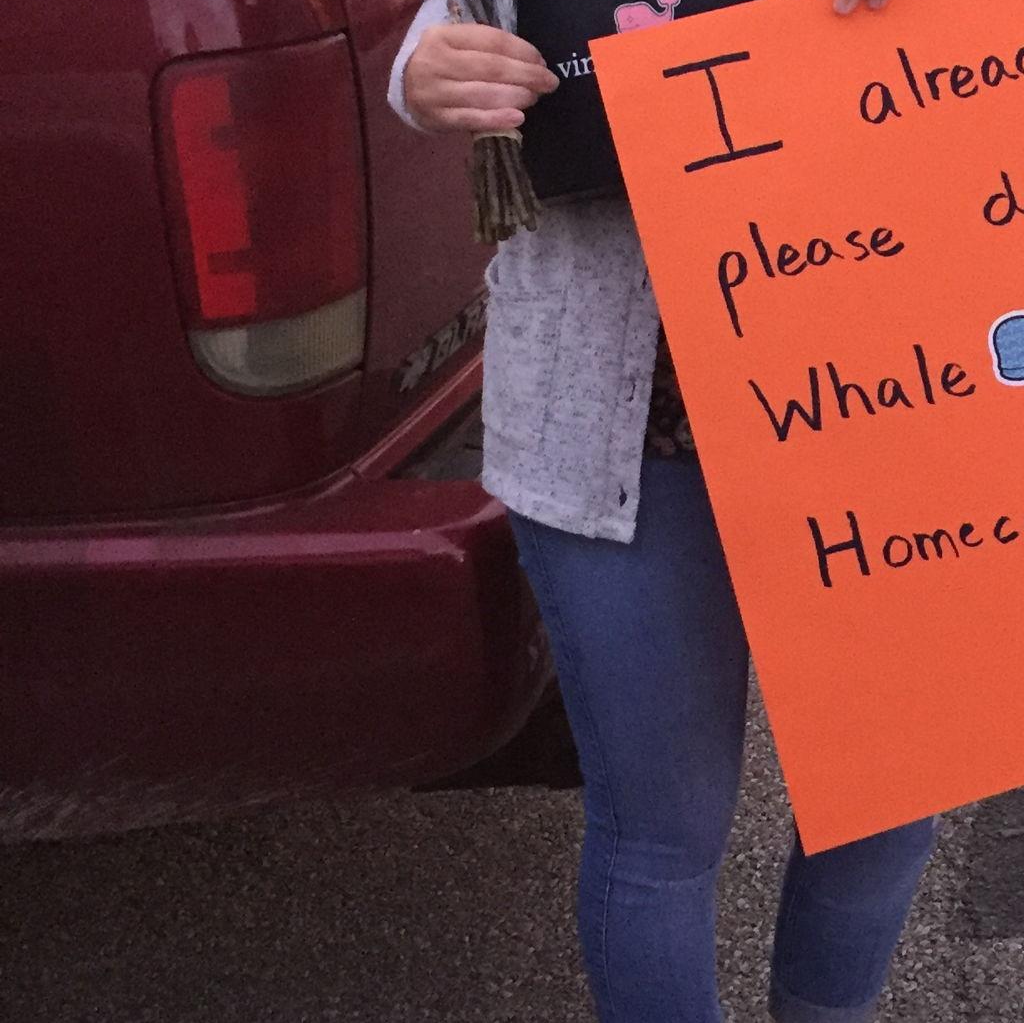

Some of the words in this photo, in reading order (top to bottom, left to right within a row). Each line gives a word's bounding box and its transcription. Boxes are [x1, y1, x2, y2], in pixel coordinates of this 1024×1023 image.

[662, 51, 784, 173] I
[717, 221, 905, 338] please
[748, 344, 977, 442] Whale
